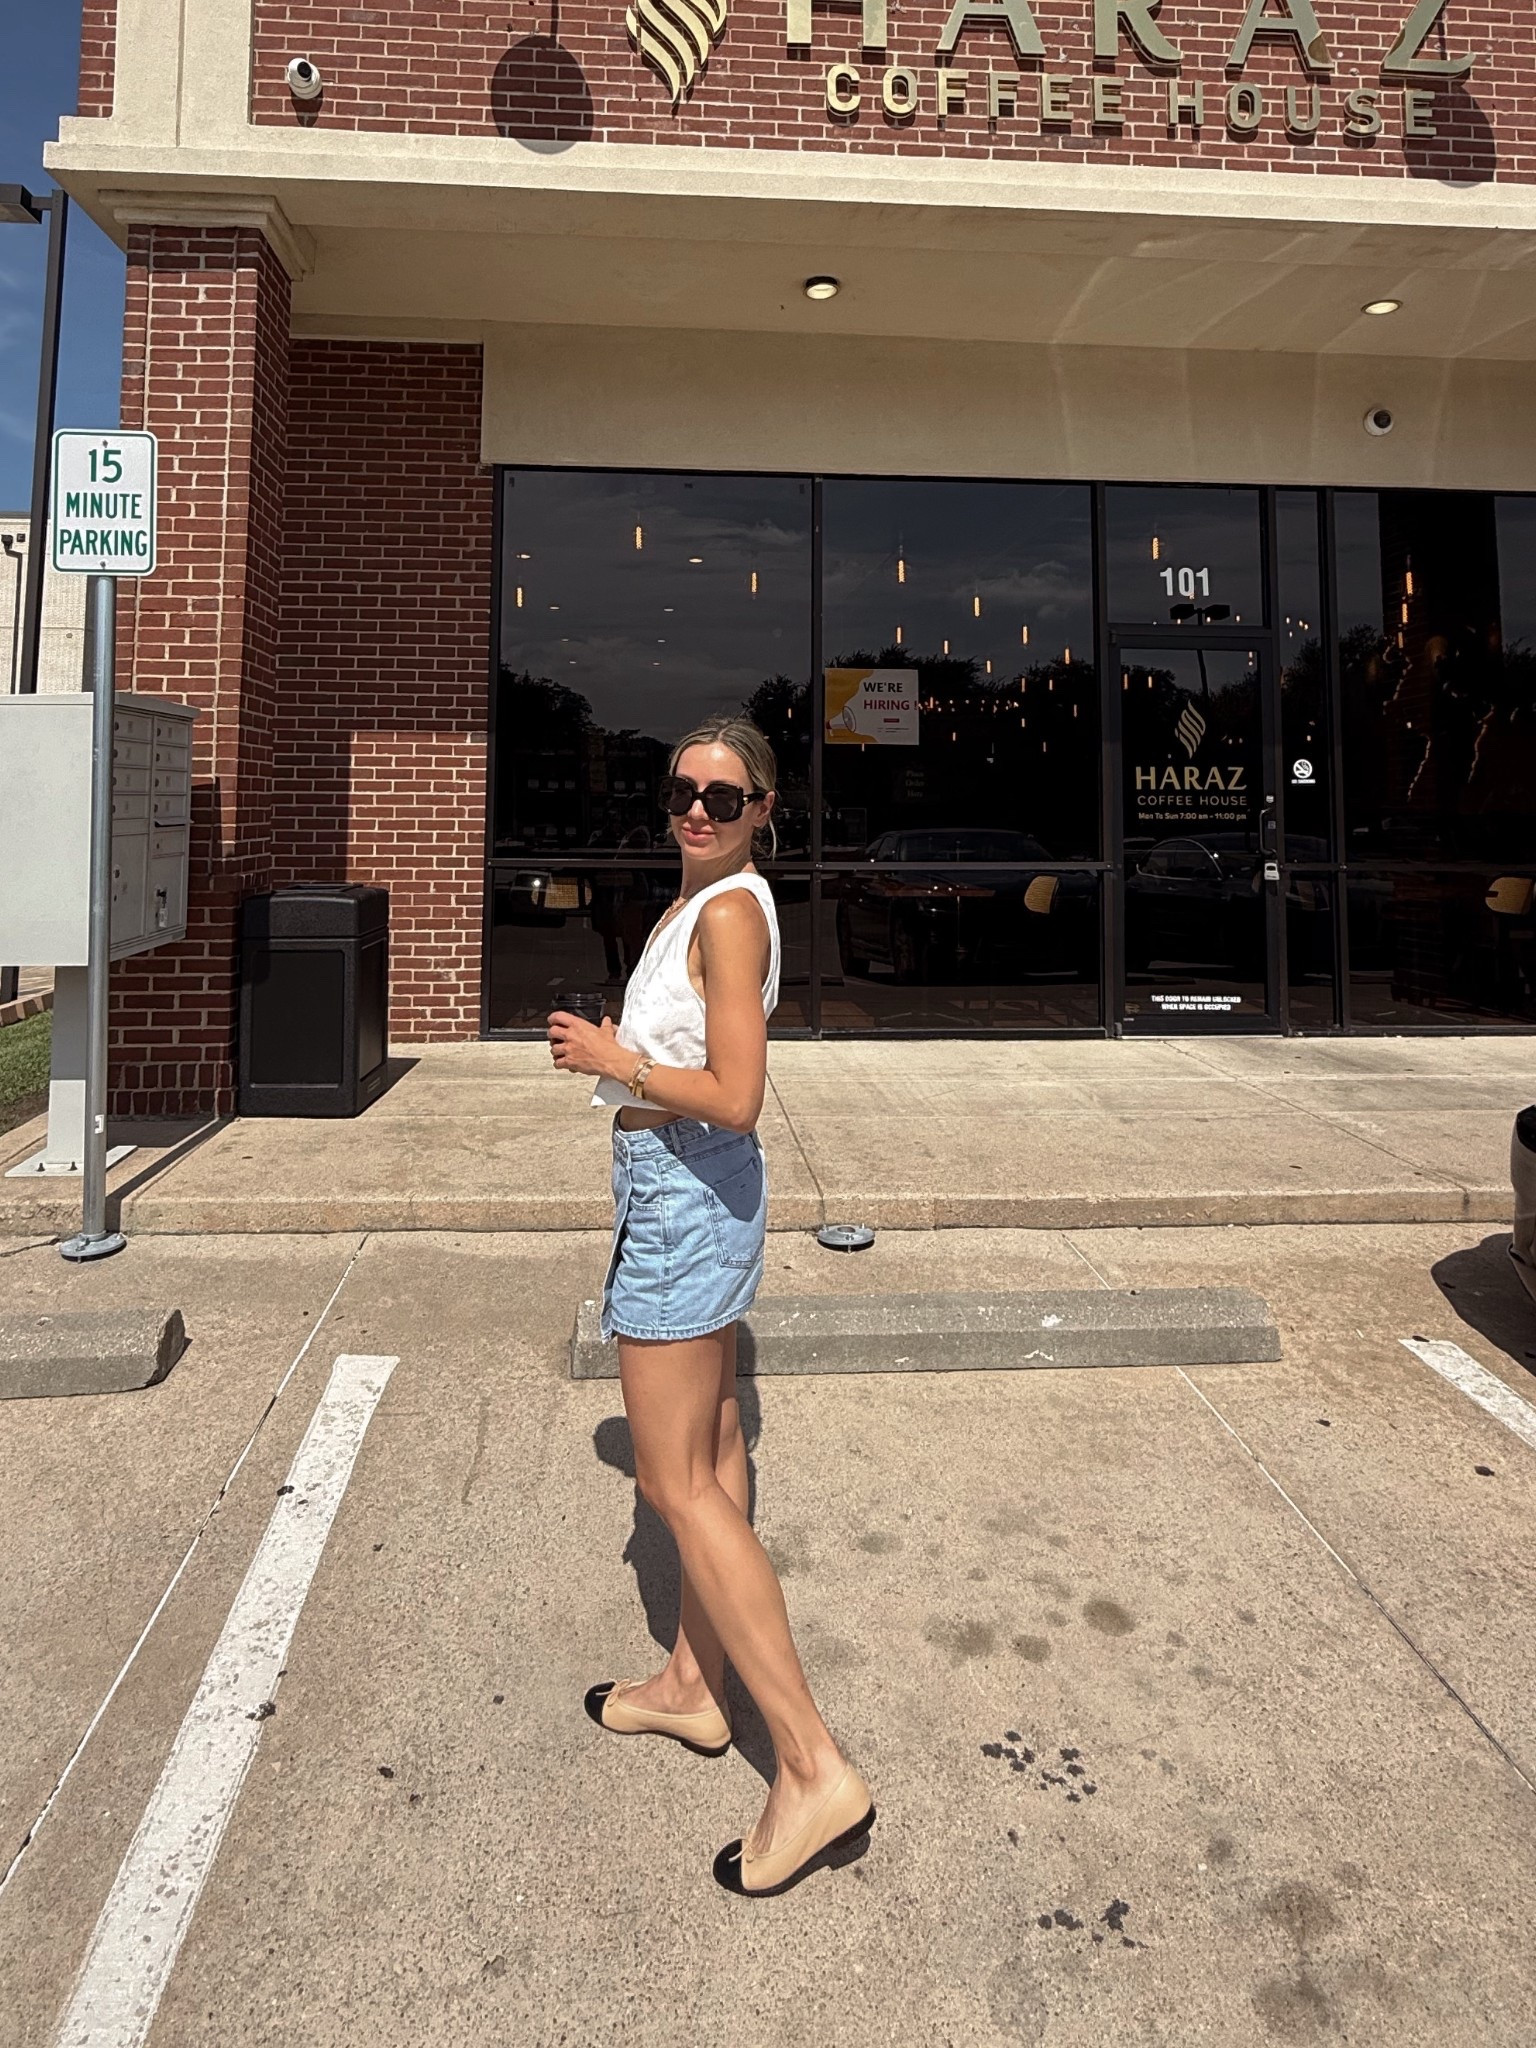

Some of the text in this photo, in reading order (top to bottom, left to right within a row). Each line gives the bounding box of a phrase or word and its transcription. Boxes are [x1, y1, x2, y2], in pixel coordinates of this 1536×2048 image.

[826, 64, 1438, 137] COFFEE HOUSE
[88, 448, 123, 483] 15
[65, 492, 143, 519] MINUTE
[59, 529, 148, 557] PARKING
[1159, 567, 1210, 597] 101
[863, 681, 903, 693] WE'RE
[863, 699, 910, 711] HIRING
[1135, 766, 1247, 790] HARAZ
[1137, 795, 1248, 806] COFFEE HOUSE
[1138, 812, 1153, 820] Mon
[1155, 812, 1163, 820] To
[1164, 812, 1178, 820] Sun
[1179, 812, 1197, 820] 7:00
[1215, 812, 1235, 820] 11:00
[1236, 813, 1247, 822] pm
